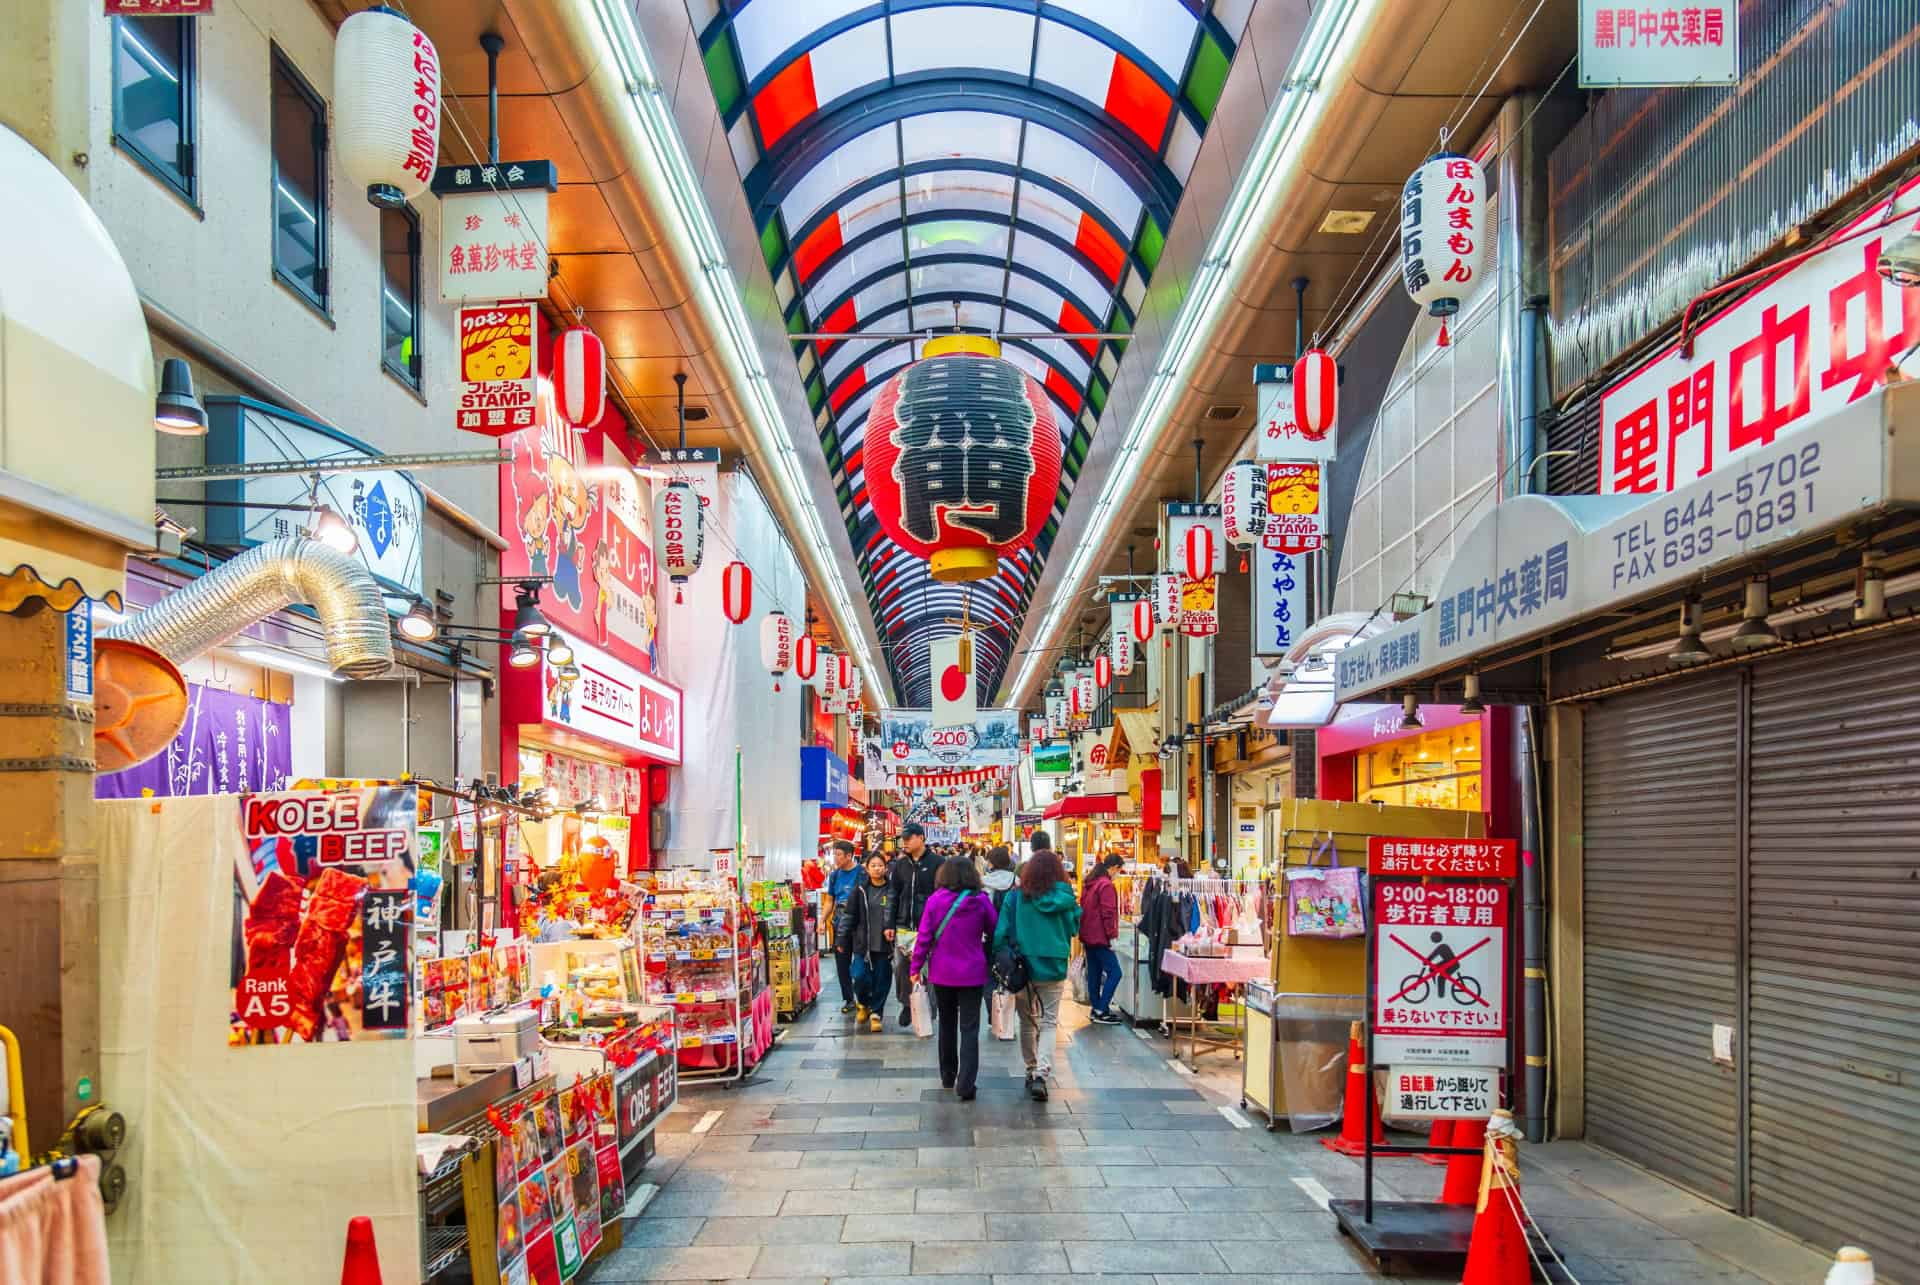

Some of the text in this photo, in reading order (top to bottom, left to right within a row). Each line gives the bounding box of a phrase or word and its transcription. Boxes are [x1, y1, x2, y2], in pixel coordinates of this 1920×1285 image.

[1594, 8, 1724, 48] 黒門中央薬局
[465, 214, 522, 232] 珍味
[1443, 161, 1475, 283] ほんまもん
[449, 240, 538, 274] 魚萬珍味堂
[463, 312, 507, 331] クロモン
[467, 380, 523, 394] フレッシュ
[462, 392, 531, 408] STAMP
[462, 409, 531, 427] 加盟店
[1613, 442, 1820, 559] TEL 644-5702
[1267, 524, 1318, 534] STAMP
[1612, 483, 1815, 591] FAX 633-0831
[609, 525, 650, 596] よしや
[1272, 553, 1295, 647] みやもと
[1439, 541, 1568, 648] 黒門中央薬局
[642, 694, 674, 743] よしや
[932, 732, 967, 746] 200
[248, 797, 358, 835] KOBE
[320, 831, 406, 862] BEEF
[1383, 843, 1504, 858] 自転車は必ず降りて
[1382, 857, 1500, 871] 通行してください！
[1386, 904, 1493, 925] 歩行者専用
[366, 896, 401, 1022] 神戸牛
[245, 978, 287, 993] Rank
[244, 995, 290, 1017] A5
[1401, 1094, 1487, 1111] 通行して下さい
